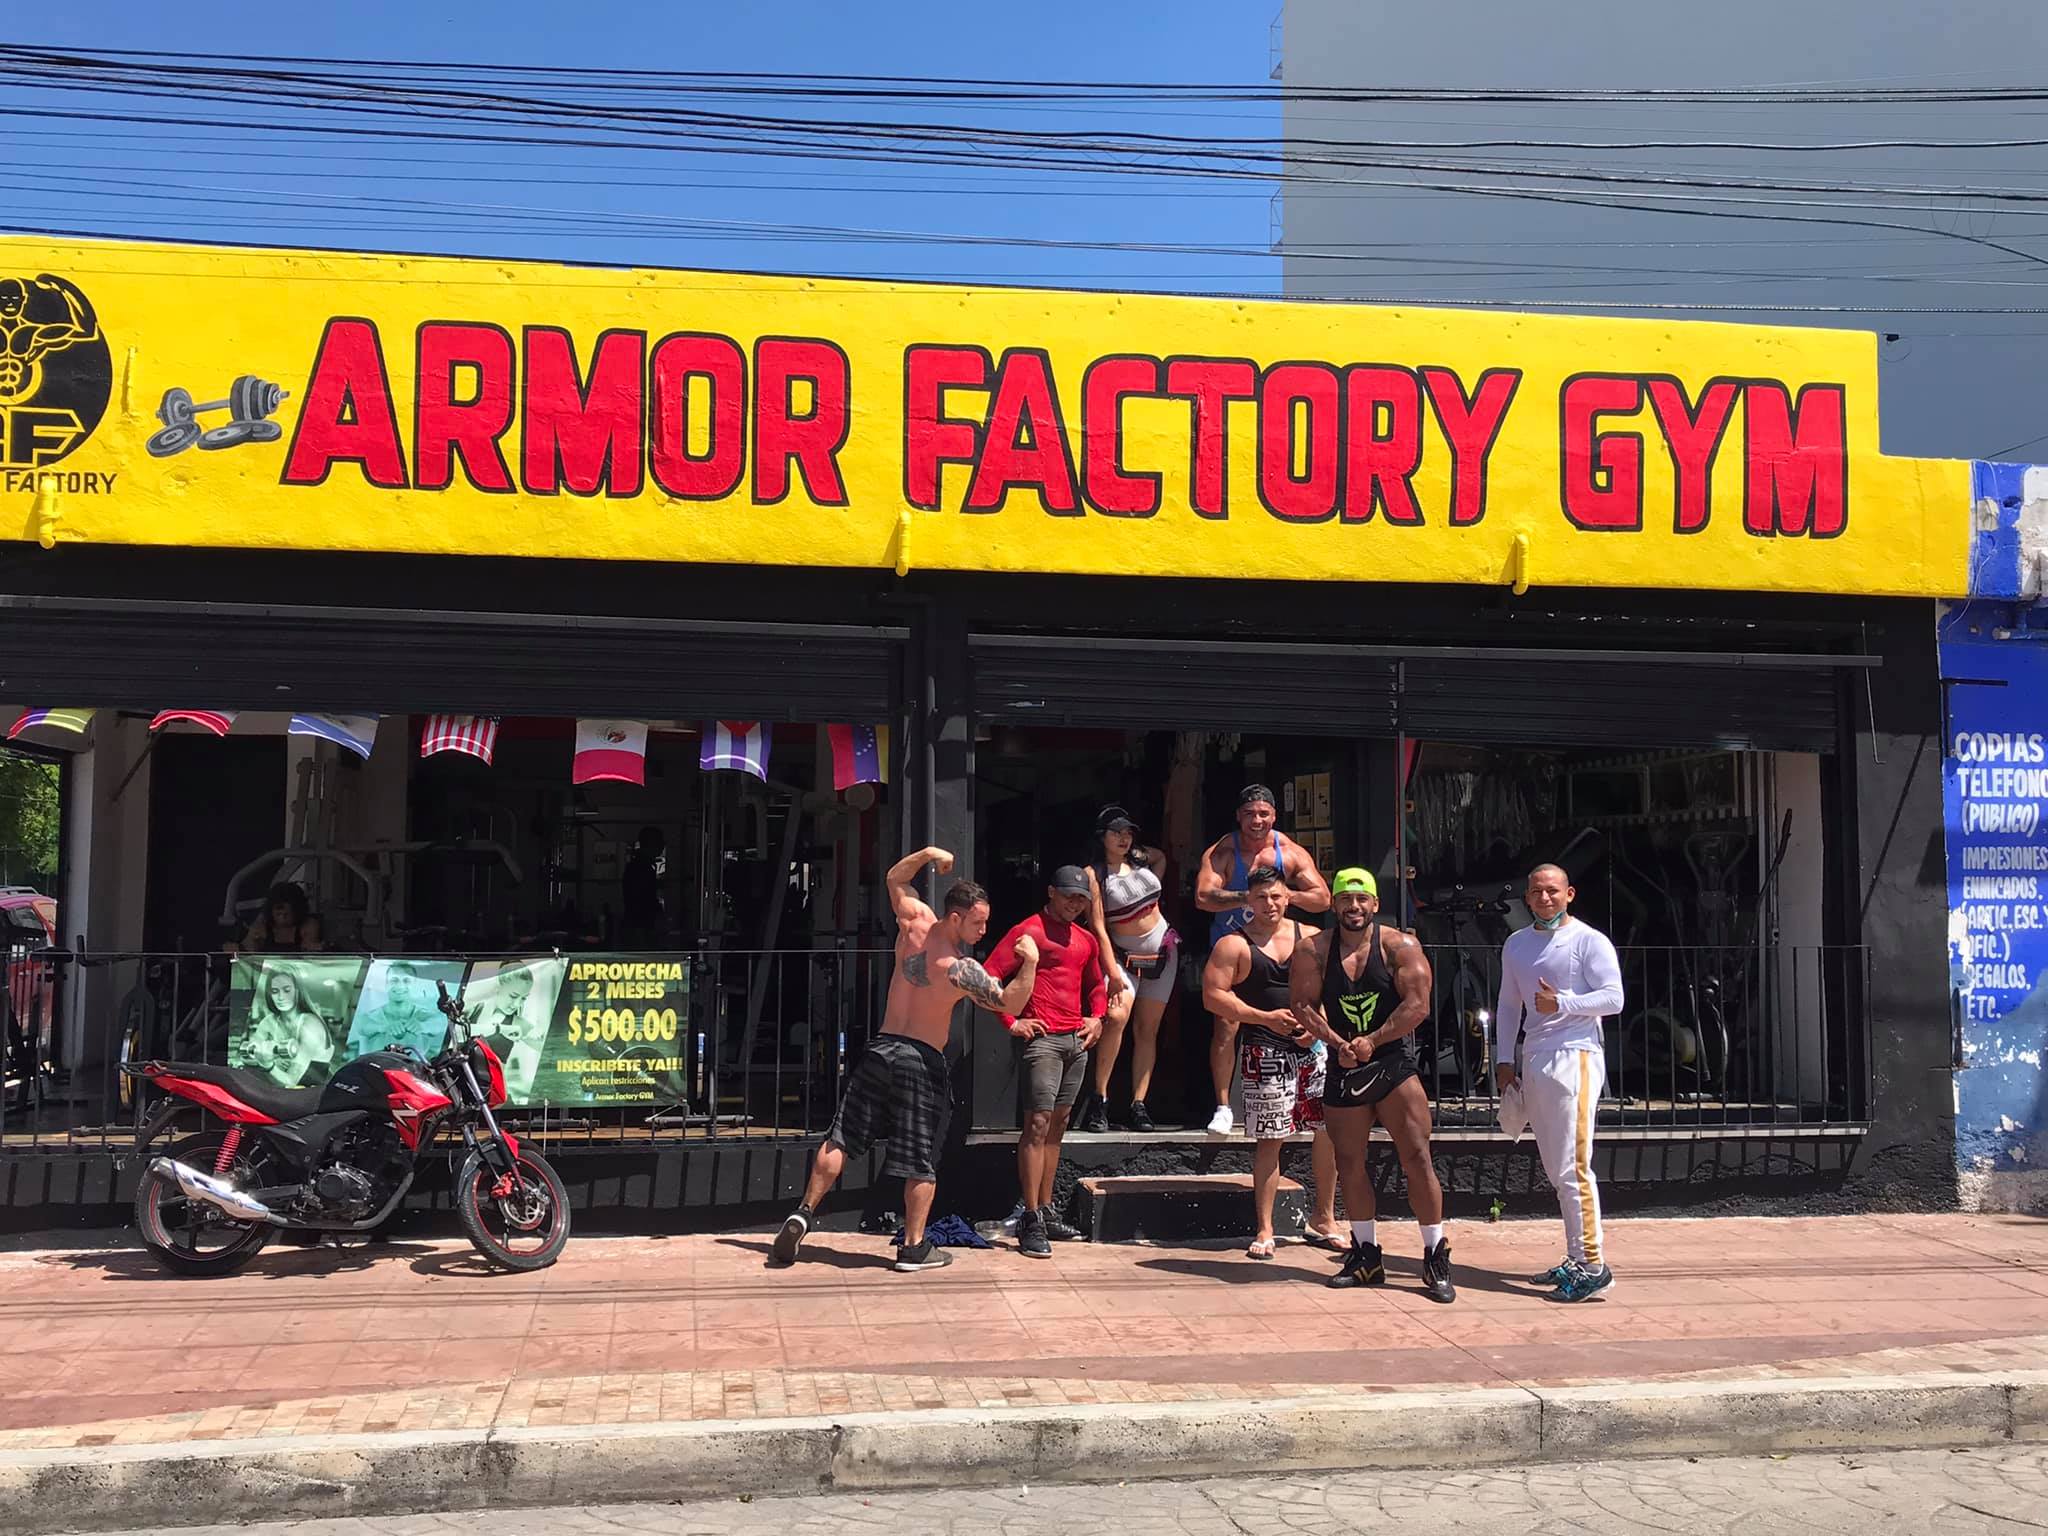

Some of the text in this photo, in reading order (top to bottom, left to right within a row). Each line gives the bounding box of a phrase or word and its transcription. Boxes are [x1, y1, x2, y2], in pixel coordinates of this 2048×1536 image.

[280, 315, 1850, 539] ARMOR FACTORY GYM
[1955, 732, 2044, 763] COPIAS
[1962, 799, 2040, 838] (PUBLICO)
[1962, 846, 2048, 871] IMPRESIONES
[569, 963, 683, 981] APROVECHA
[587, 982, 665, 999] 2 MESES
[568, 1005, 678, 1046] $500.00
[557, 1057, 683, 1072] INSCRIBETE YA!!!
[581, 1075, 656, 1087] Aplican restricciones
[615, 1092, 638, 1101] Factory
